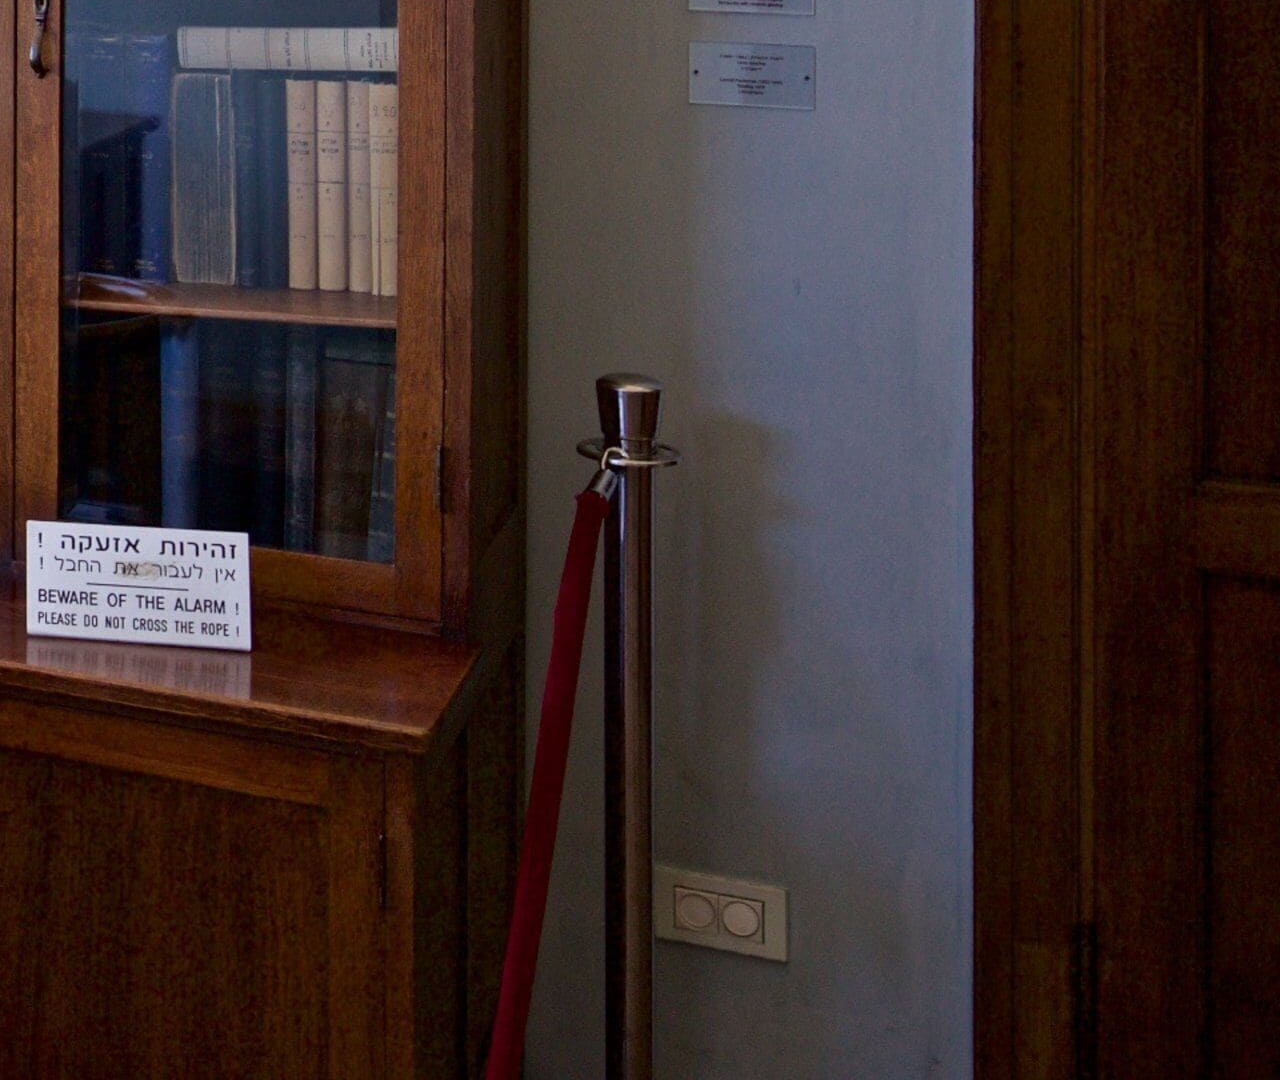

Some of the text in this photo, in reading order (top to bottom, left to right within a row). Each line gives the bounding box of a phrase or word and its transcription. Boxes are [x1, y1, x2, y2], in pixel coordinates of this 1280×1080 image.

[60, 533, 140, 554] אזעקה
[159, 538, 238, 559] זהירות
[54, 556, 102, 573] החבל
[154, 563, 203, 579] לעבור
[214, 567, 236, 584] אין
[38, 588, 98, 606] BEWARE
[107, 592, 127, 608] OF
[136, 594, 165, 610] THE
[173, 597, 226, 615] ALARM
[37, 611, 77, 626] PLEASE
[84, 615, 98, 628] DO
[105, 616, 126, 629] NOT
[132, 617, 168, 633] CROSS
[174, 620, 195, 634] THE
[201, 622, 230, 637] ROPE
